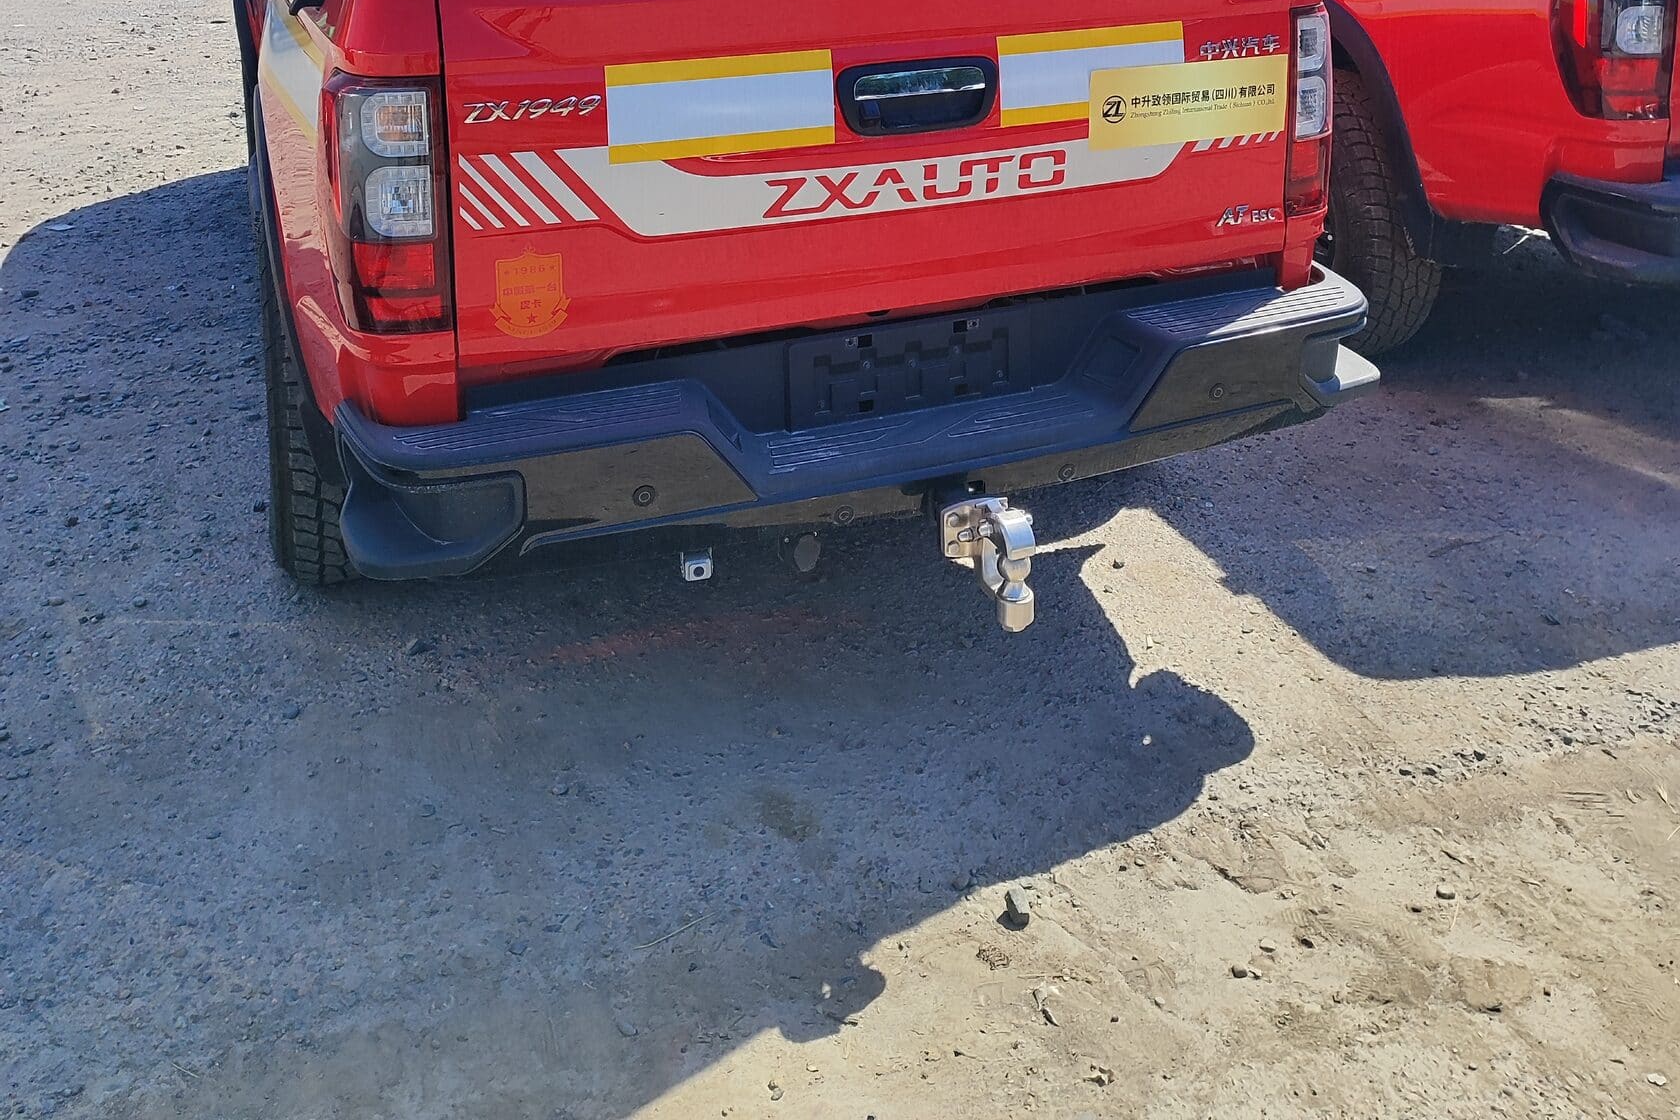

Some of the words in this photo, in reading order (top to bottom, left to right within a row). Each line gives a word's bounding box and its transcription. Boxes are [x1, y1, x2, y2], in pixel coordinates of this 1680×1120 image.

[1200, 34, 1281, 61] 中兴汽车
[463, 94, 602, 124] ZX1949
[1214, 103, 1228, 111] Trade
[762, 149, 1067, 219] ZXAUTO
[1252, 208, 1276, 223] ESC
[513, 265, 545, 275] 1986
[520, 299, 542, 310] 皮卡
